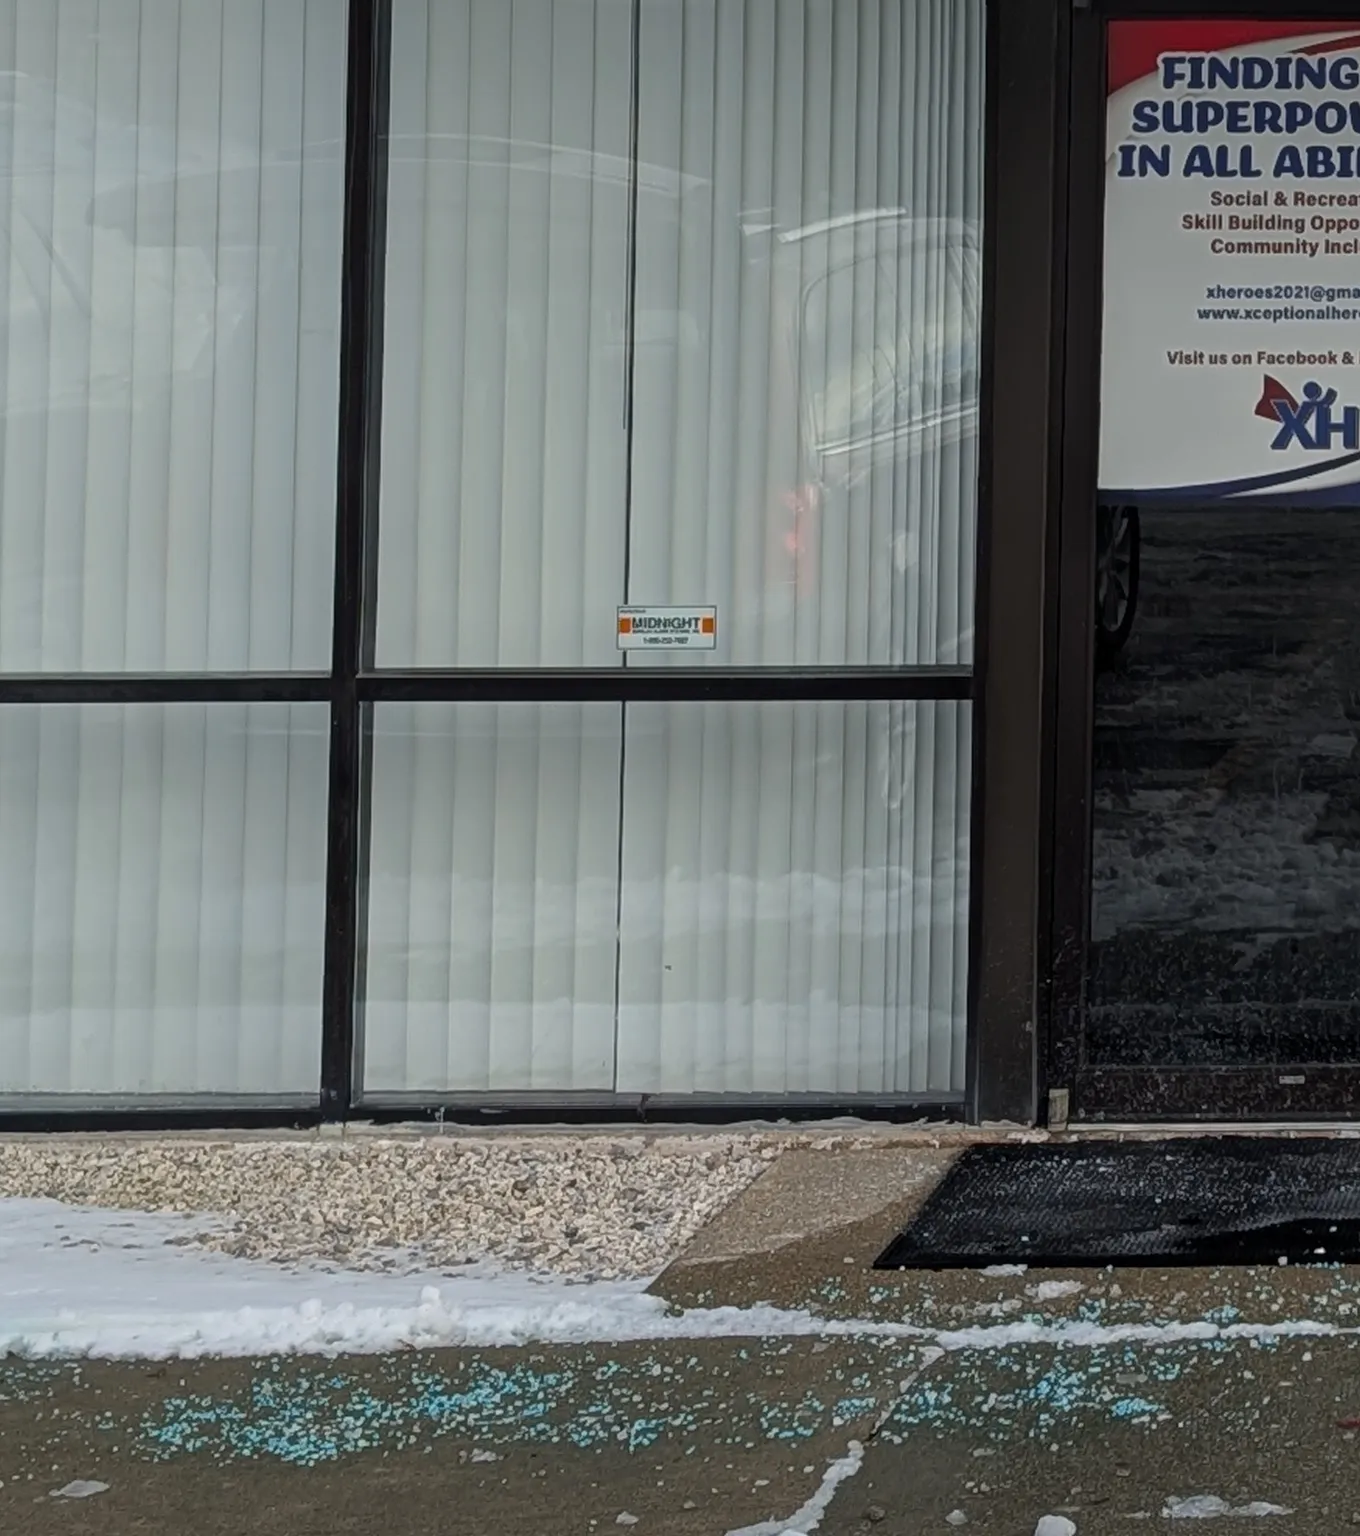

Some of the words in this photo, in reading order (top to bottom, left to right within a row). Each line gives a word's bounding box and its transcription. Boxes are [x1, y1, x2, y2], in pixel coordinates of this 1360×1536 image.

[1160, 55, 1360, 90] FINDING
[1116, 144, 1171, 178] IN
[1182, 144, 1262, 178] ALL
[1210, 190, 1269, 207] Social
[1273, 191, 1289, 207] &
[1181, 214, 1223, 231] Skill
[1228, 214, 1306, 234] Building
[1210, 238, 1319, 257] Community
[1166, 351, 1205, 365] Visit
[1208, 353, 1228, 365] us
[1231, 353, 1252, 365] on
[1256, 350, 1338, 366] Facebook
[1341, 351, 1355, 366] &
